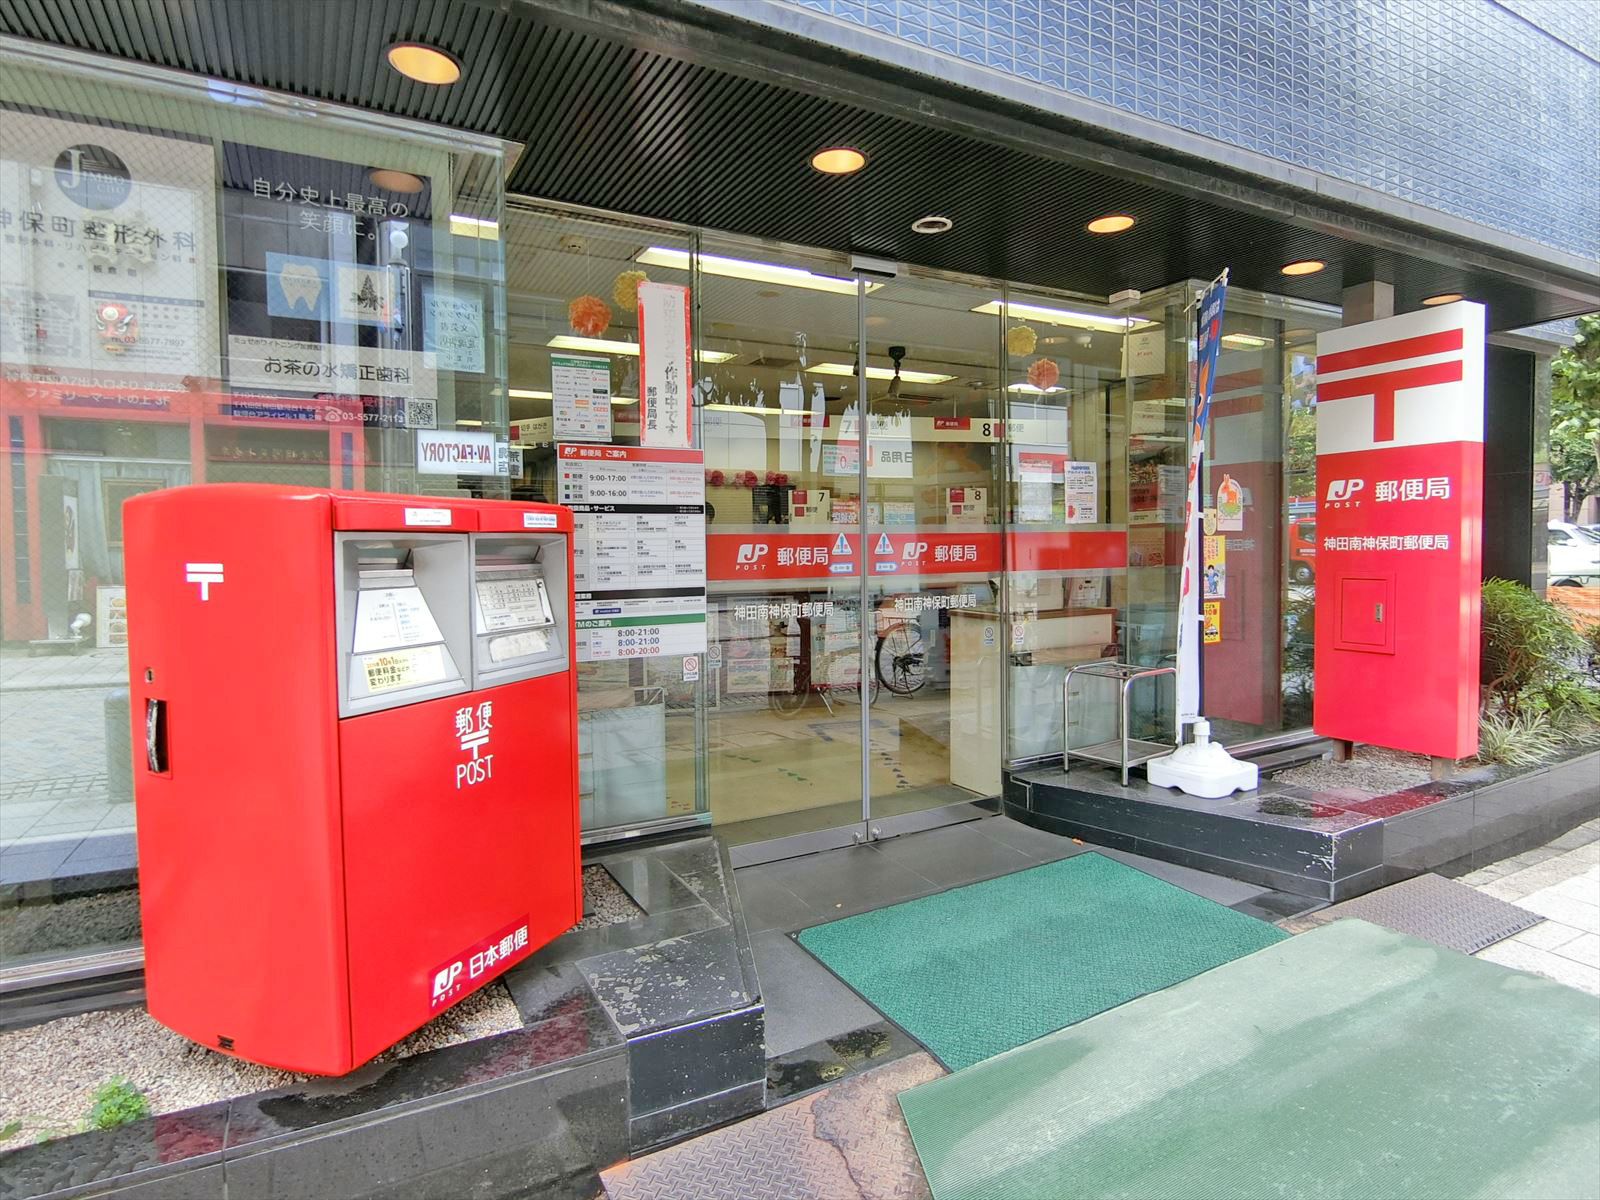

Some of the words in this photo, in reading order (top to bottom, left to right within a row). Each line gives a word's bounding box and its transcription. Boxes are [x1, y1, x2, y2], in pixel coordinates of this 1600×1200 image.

[254, 177, 408, 217] 自分史上最高の
[264, 357, 410, 384] お茶の水矯正歯科
[647, 386, 657, 430] 郵便局長
[982, 423, 991, 436] 8
[605, 450, 627, 459] ご案内
[589, 474, 627, 482] 9:00-17:00
[590, 489, 627, 497] 9:00-16:00
[818, 492, 825, 502] 7
[975, 490, 981, 500] 8
[1326, 479, 1365, 501] JP
[1375, 477, 1450, 503] 郵便局
[1324, 501, 1361, 509] POST
[902, 542, 928, 560] JP
[934, 544, 977, 563] 郵便局
[1324, 534, 1449, 551] 神田南神保町郵便局
[737, 543, 769, 563] JP
[777, 546, 829, 567] 郵便局
[734, 601, 834, 621] 神田南神保町郵便局
[894, 593, 977, 613] 神田南神保町郵便局
[617, 627, 660, 638] 8:00-21:00
[618, 637, 660, 647] 8:00-21:00
[617, 646, 660, 656] 8:00-20:00
[370, 674, 401, 687] 変わります
[455, 701, 494, 738] 郵便
[456, 753, 494, 790] POST
[433, 961, 463, 998] JP
[469, 925, 529, 979] 日本郵便
[431, 983, 462, 1008] POST
